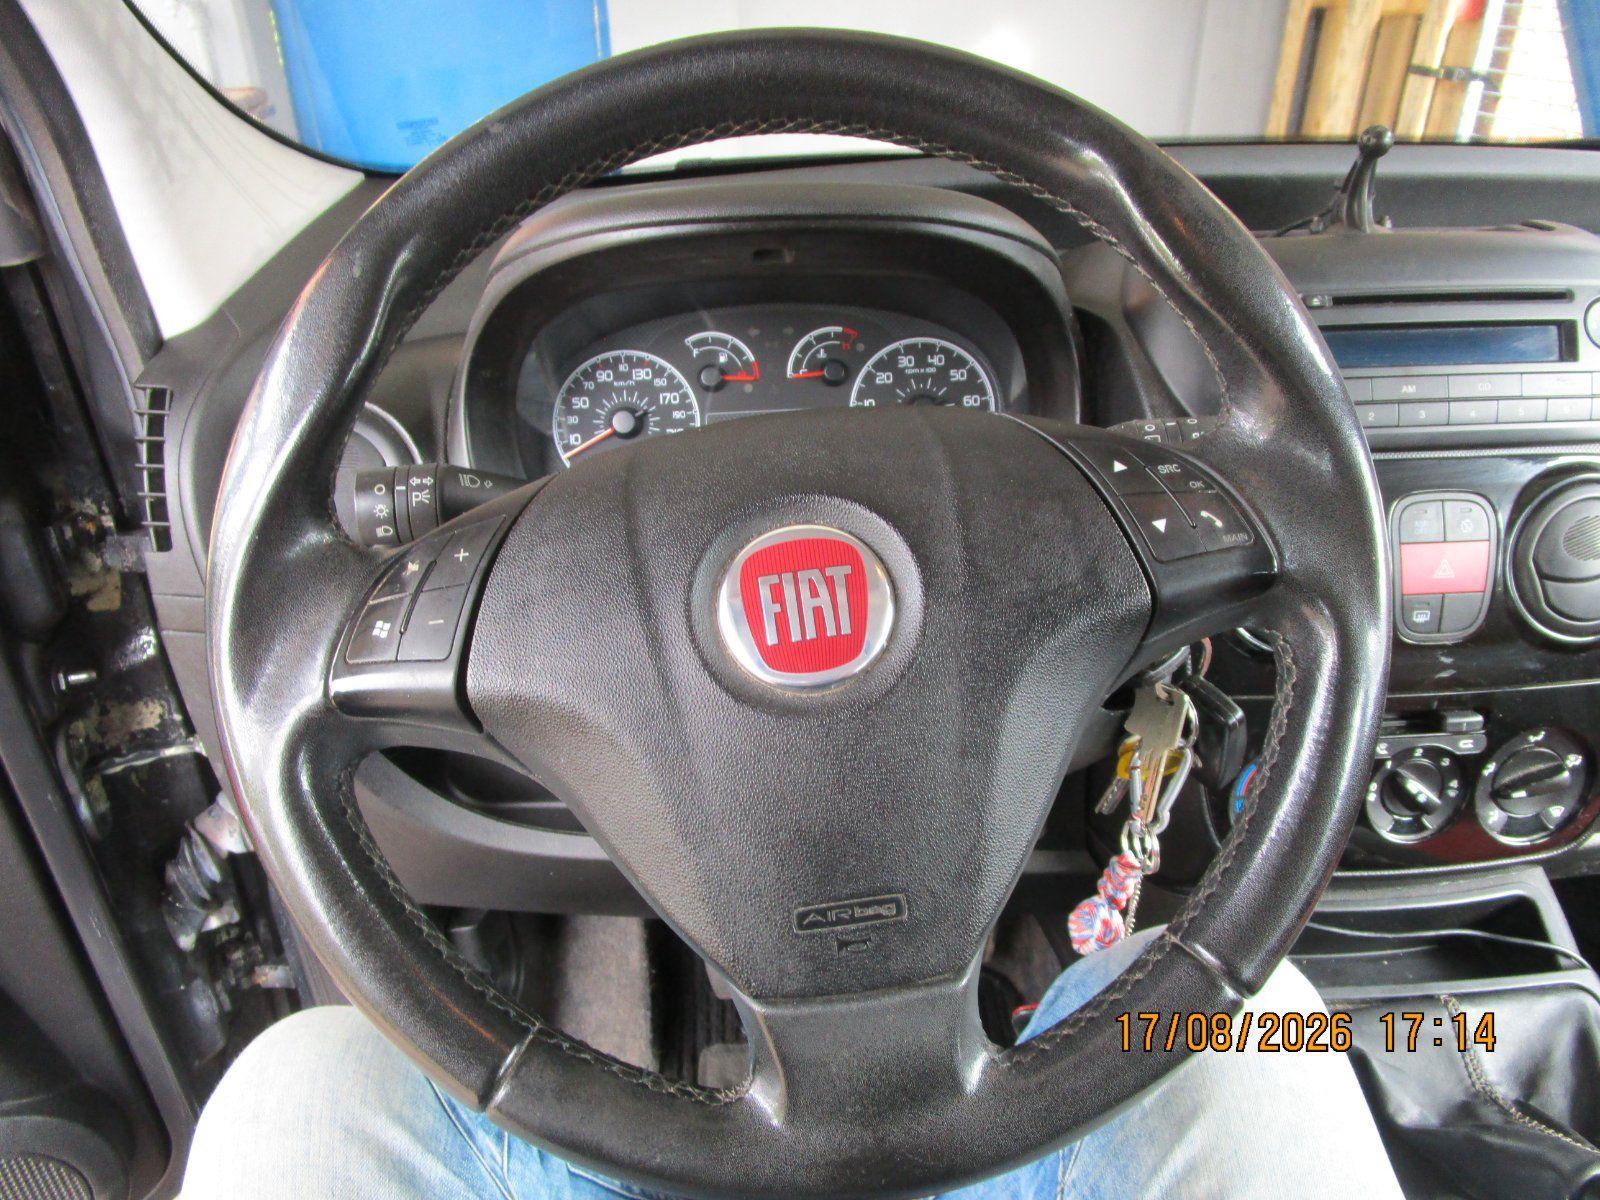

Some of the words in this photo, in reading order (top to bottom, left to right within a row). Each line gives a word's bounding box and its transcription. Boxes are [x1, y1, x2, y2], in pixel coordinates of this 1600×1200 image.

[898, 355, 915, 368] 30
[927, 354, 945, 366] 40
[618, 363, 629, 372] 110
[596, 370, 613, 382] 90
[632, 368, 652, 380] 130
[875, 372, 893, 384] 20
[950, 369, 967, 381] 50
[583, 381, 595, 390] 70
[613, 379, 635, 388] km/h
[653, 378, 667, 387] 150
[1402, 385, 1417, 394] AM
[571, 397, 589, 409] 50
[659, 392, 680, 405] 170
[963, 394, 980, 407] 60
[567, 415, 579, 424] 30
[1368, 411, 1375, 421] 2
[1419, 410, 1426, 419] 3
[569, 433, 581, 445] 10
[1157, 463, 1181, 474] SRC
[1189, 480, 1205, 489] OK
[757, 565, 852, 647] FIAT
[1413, 748, 1424, 757] 2
